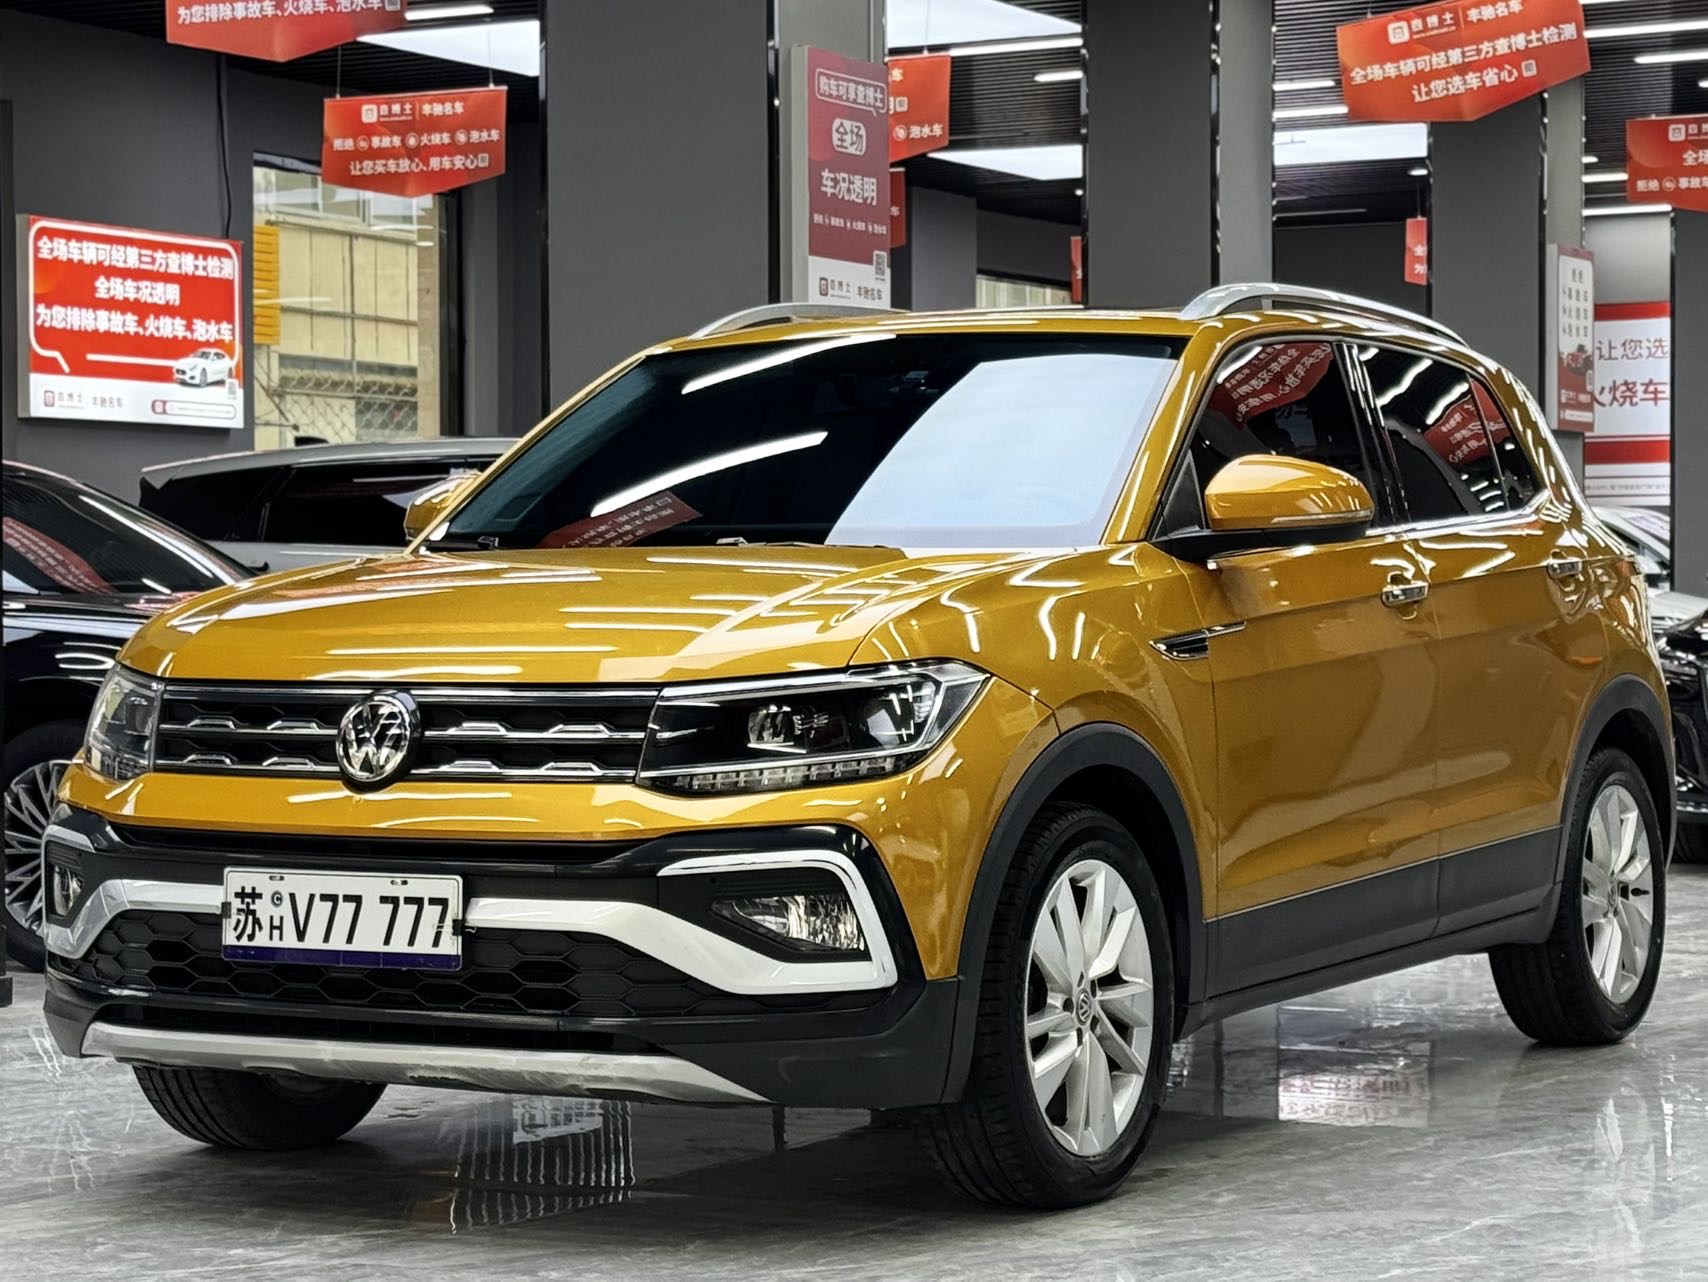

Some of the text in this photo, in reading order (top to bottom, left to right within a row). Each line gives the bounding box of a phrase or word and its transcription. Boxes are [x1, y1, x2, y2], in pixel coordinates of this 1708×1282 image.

[1350, 22, 1577, 85] 全场车辆可经第三方查博士检测
[819, 75, 884, 107] 购车可享查博士
[1412, 65, 1518, 103] 让您选车省心
[371, 135, 402, 149] 事故车
[420, 132, 451, 146] 火烧车
[469, 129, 500, 142] 泡水车
[835, 121, 864, 151] 全场
[909, 124, 943, 139] 泡水车
[350, 153, 477, 176] 让您买车放心、用车安心
[821, 168, 877, 206] 车况透明
[37, 235, 234, 280] 全场车辆可经第三方查博士检测
[94, 275, 180, 306] 全场车况透明
[36, 303, 233, 343] 为您排除事故车、火烧车、泡水车
[1596, 337, 1669, 361] 让您选
[233, 886, 449, 948] 苏 H V77 777
